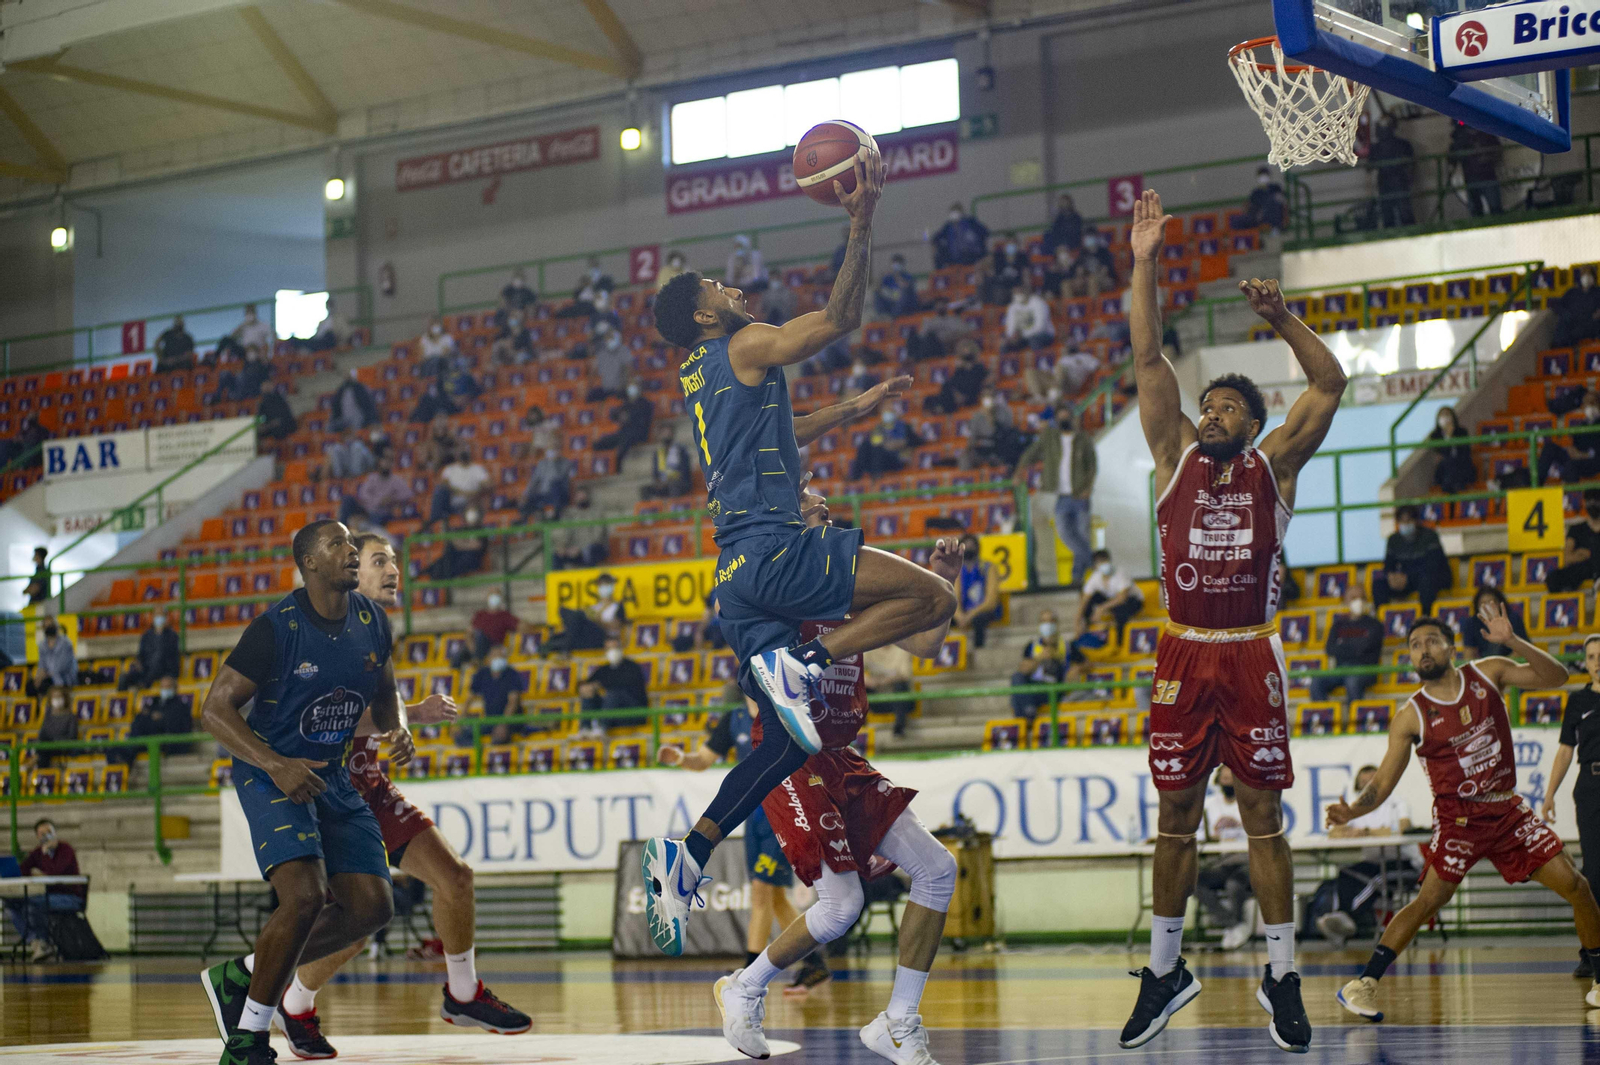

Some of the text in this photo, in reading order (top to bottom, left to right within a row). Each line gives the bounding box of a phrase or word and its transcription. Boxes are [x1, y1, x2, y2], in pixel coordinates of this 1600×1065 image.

[671, 168, 770, 208] GRADA
[1117, 181, 1136, 210] 3
[636, 250, 655, 281] 2
[127, 323, 140, 350] 1
[695, 401, 712, 466] 1
[47, 439, 120, 475] BAR
[1208, 514, 1233, 526] Ford
[1523, 500, 1549, 539] 4
[993, 546, 1012, 582] 3
[1189, 544, 1252, 561] Murcia
[557, 575, 639, 609] PISA
[1203, 574, 1230, 585] Costa
[1152, 679, 1182, 705] 32
[311, 701, 359, 721] Estrella
[311, 715, 354, 733] Galicia
[1250, 725, 1286, 741] CRC
[1515, 816, 1541, 838] CRC
[754, 853, 778, 876] 24
